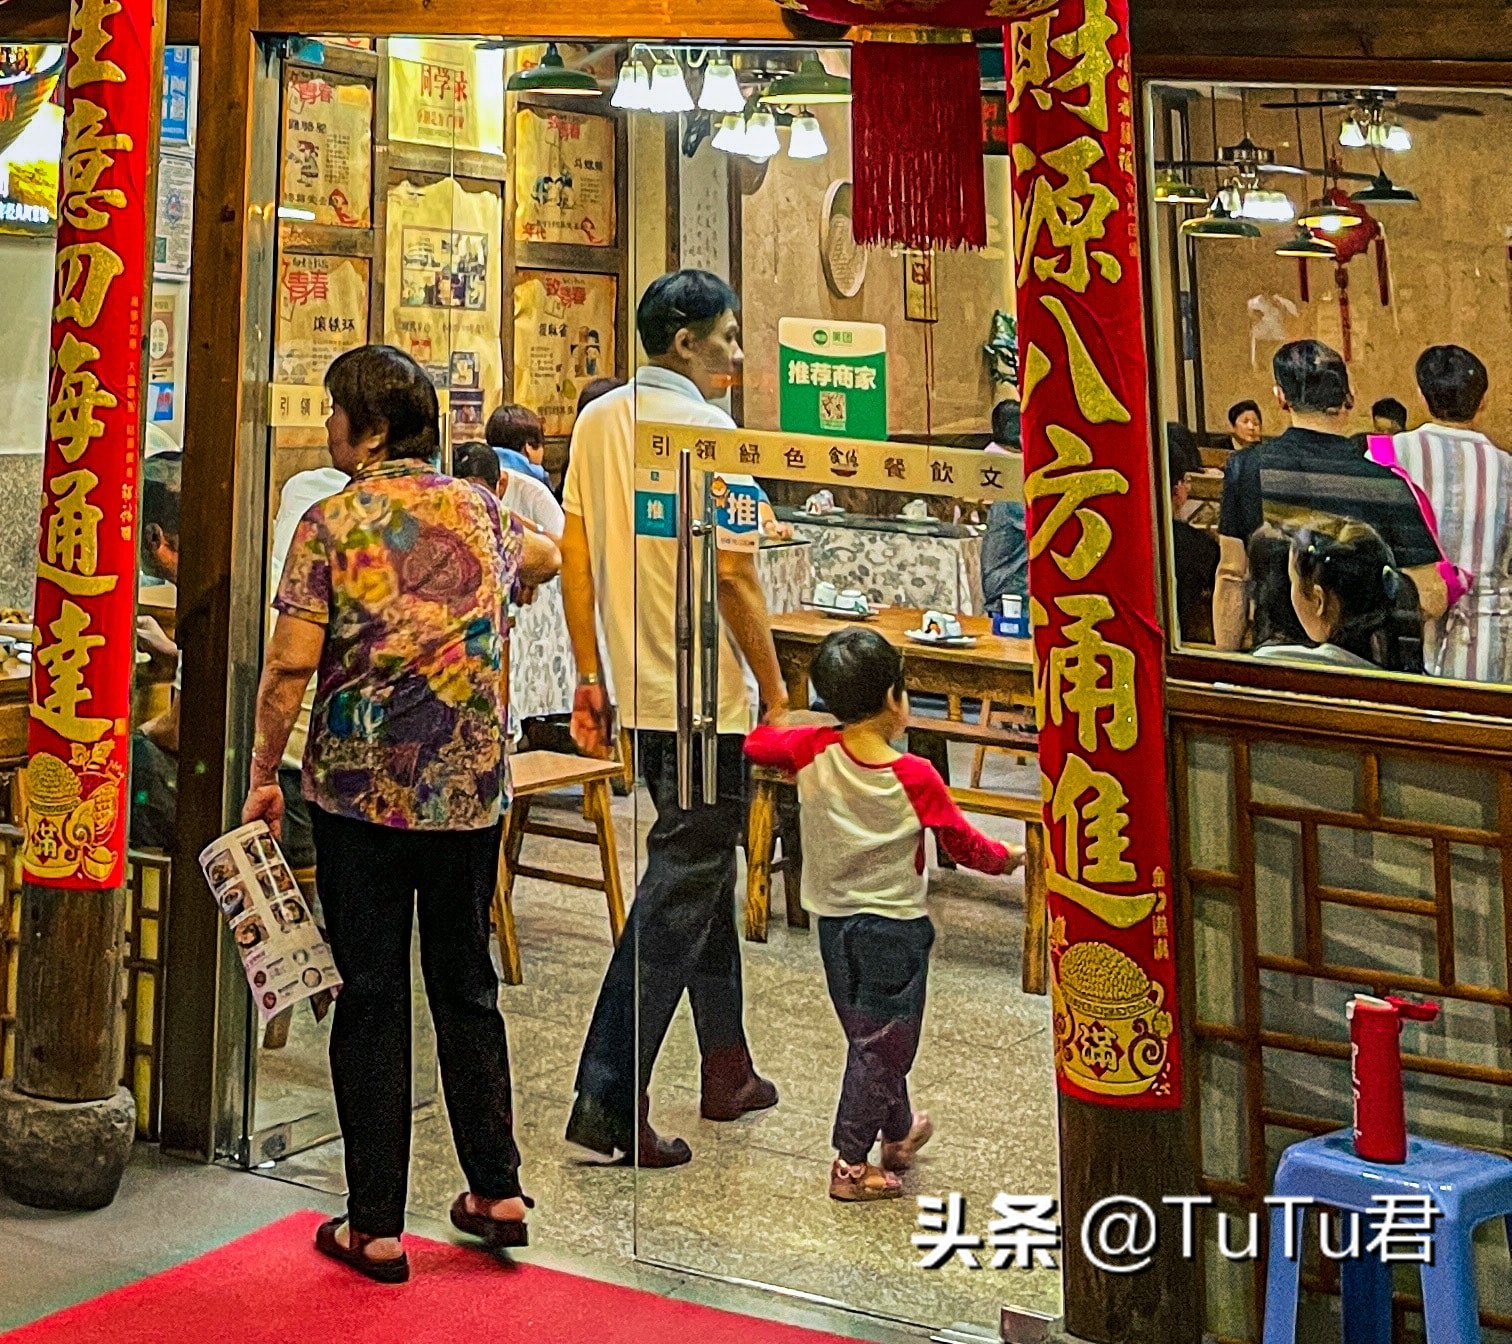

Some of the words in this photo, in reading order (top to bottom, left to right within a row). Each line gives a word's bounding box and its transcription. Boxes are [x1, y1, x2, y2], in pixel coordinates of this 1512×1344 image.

[788, 360, 876, 390] 推荐商家
[727, 492, 757, 526] 推
